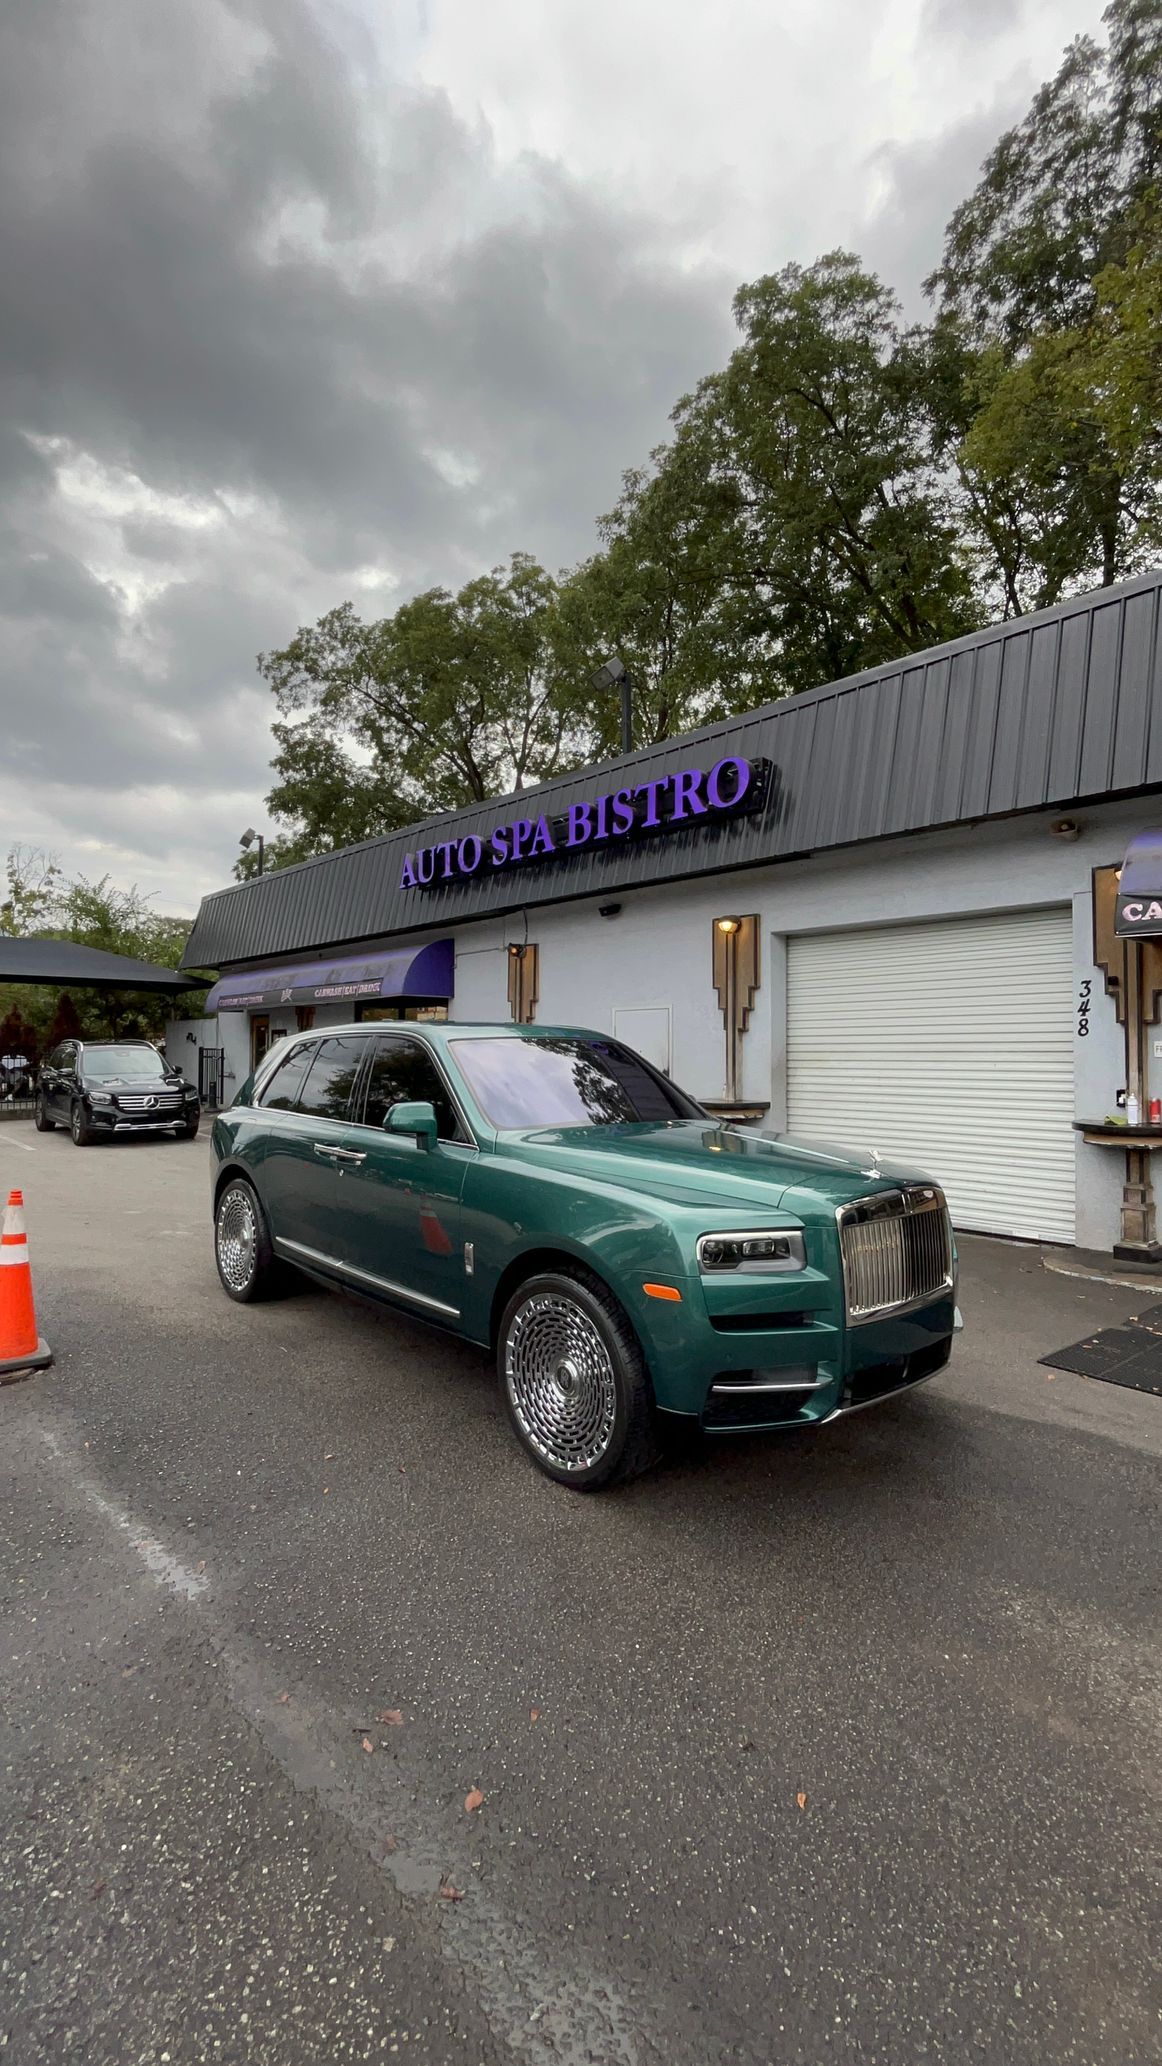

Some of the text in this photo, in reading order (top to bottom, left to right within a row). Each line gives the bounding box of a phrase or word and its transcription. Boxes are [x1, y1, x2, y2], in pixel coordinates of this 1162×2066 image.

[399, 755, 750, 889] AUTO SPA BISTRO
[1077, 979, 1092, 1036] 348
